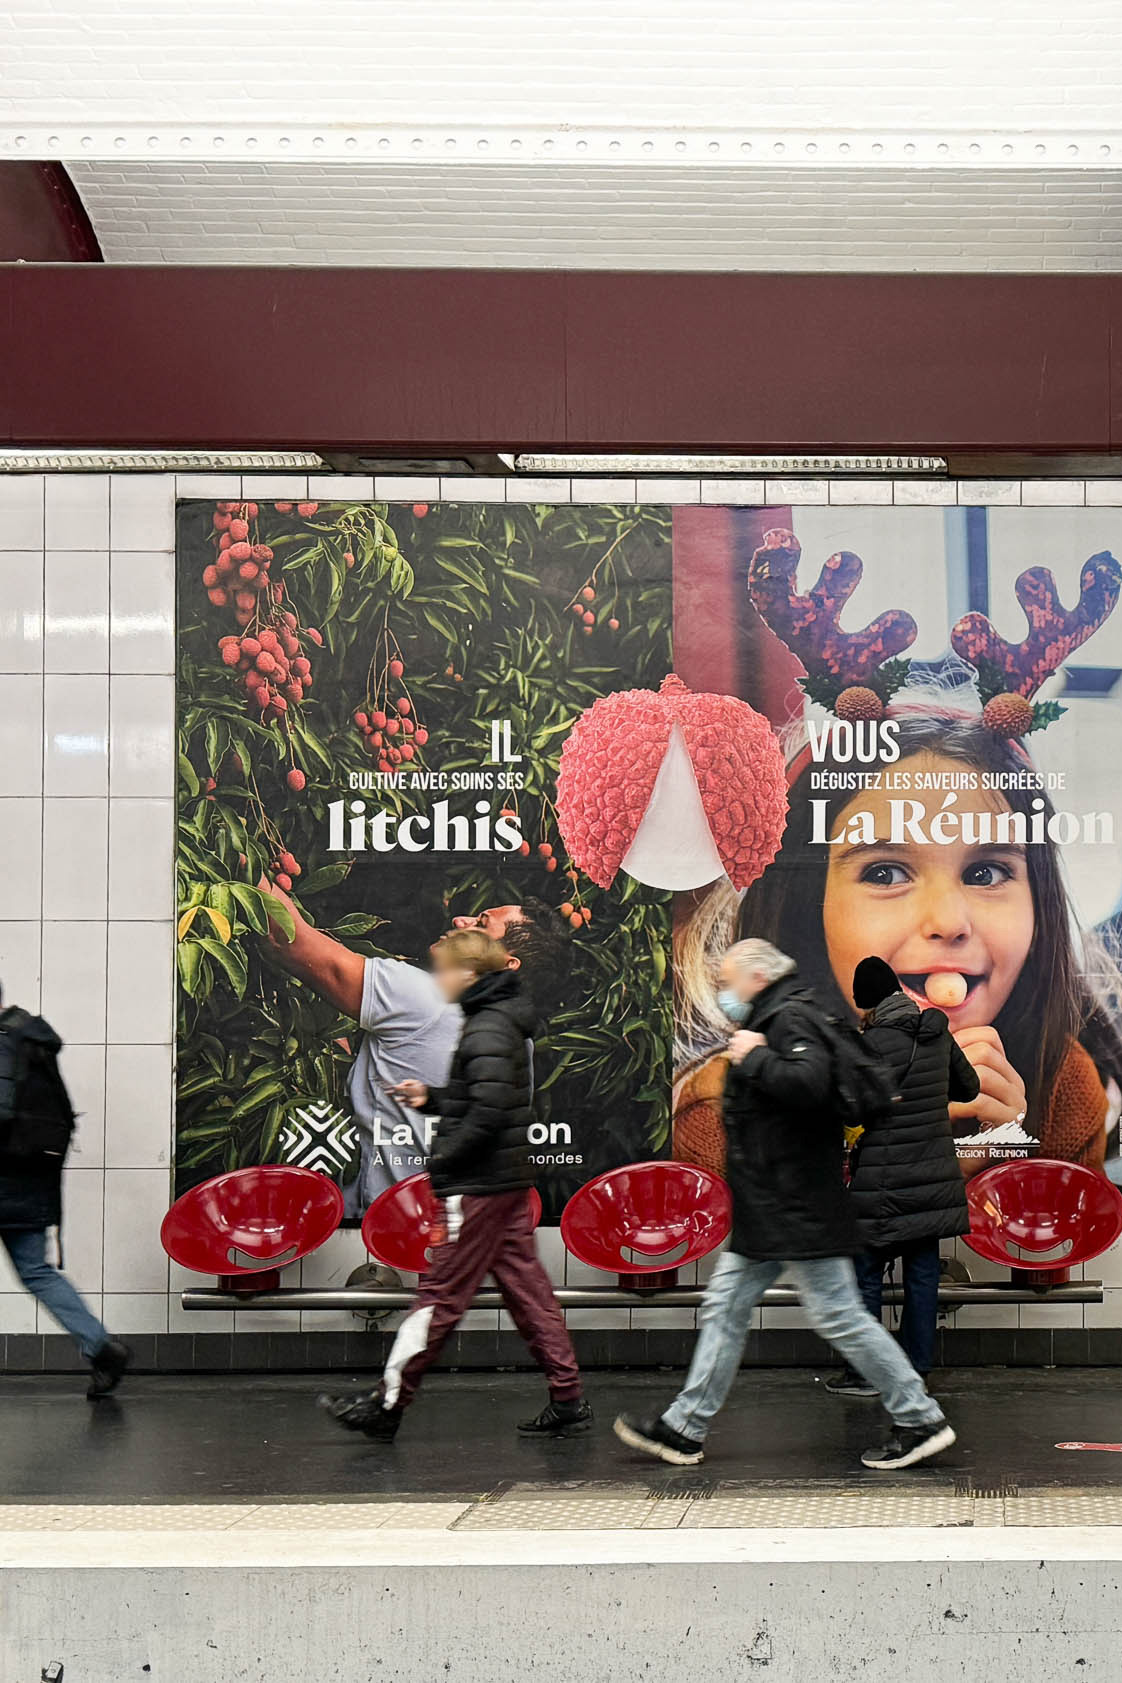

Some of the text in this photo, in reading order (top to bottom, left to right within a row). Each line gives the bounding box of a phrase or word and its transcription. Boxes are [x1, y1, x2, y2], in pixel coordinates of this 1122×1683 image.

[490, 719, 523, 763] IL
[807, 719, 901, 763] VOUS
[349, 771, 525, 790] CULTIVE AVEC SOINS SES
[810, 770, 1067, 791] DÉGUSTEZ LES SAVEURS SUCRÉES DE
[326, 799, 524, 852] litchis
[807, 791, 1116, 845] La Réunion
[373, 1116, 415, 1146] La
[373, 1151, 384, 1166] À
[389, 1153, 403, 1166] la
